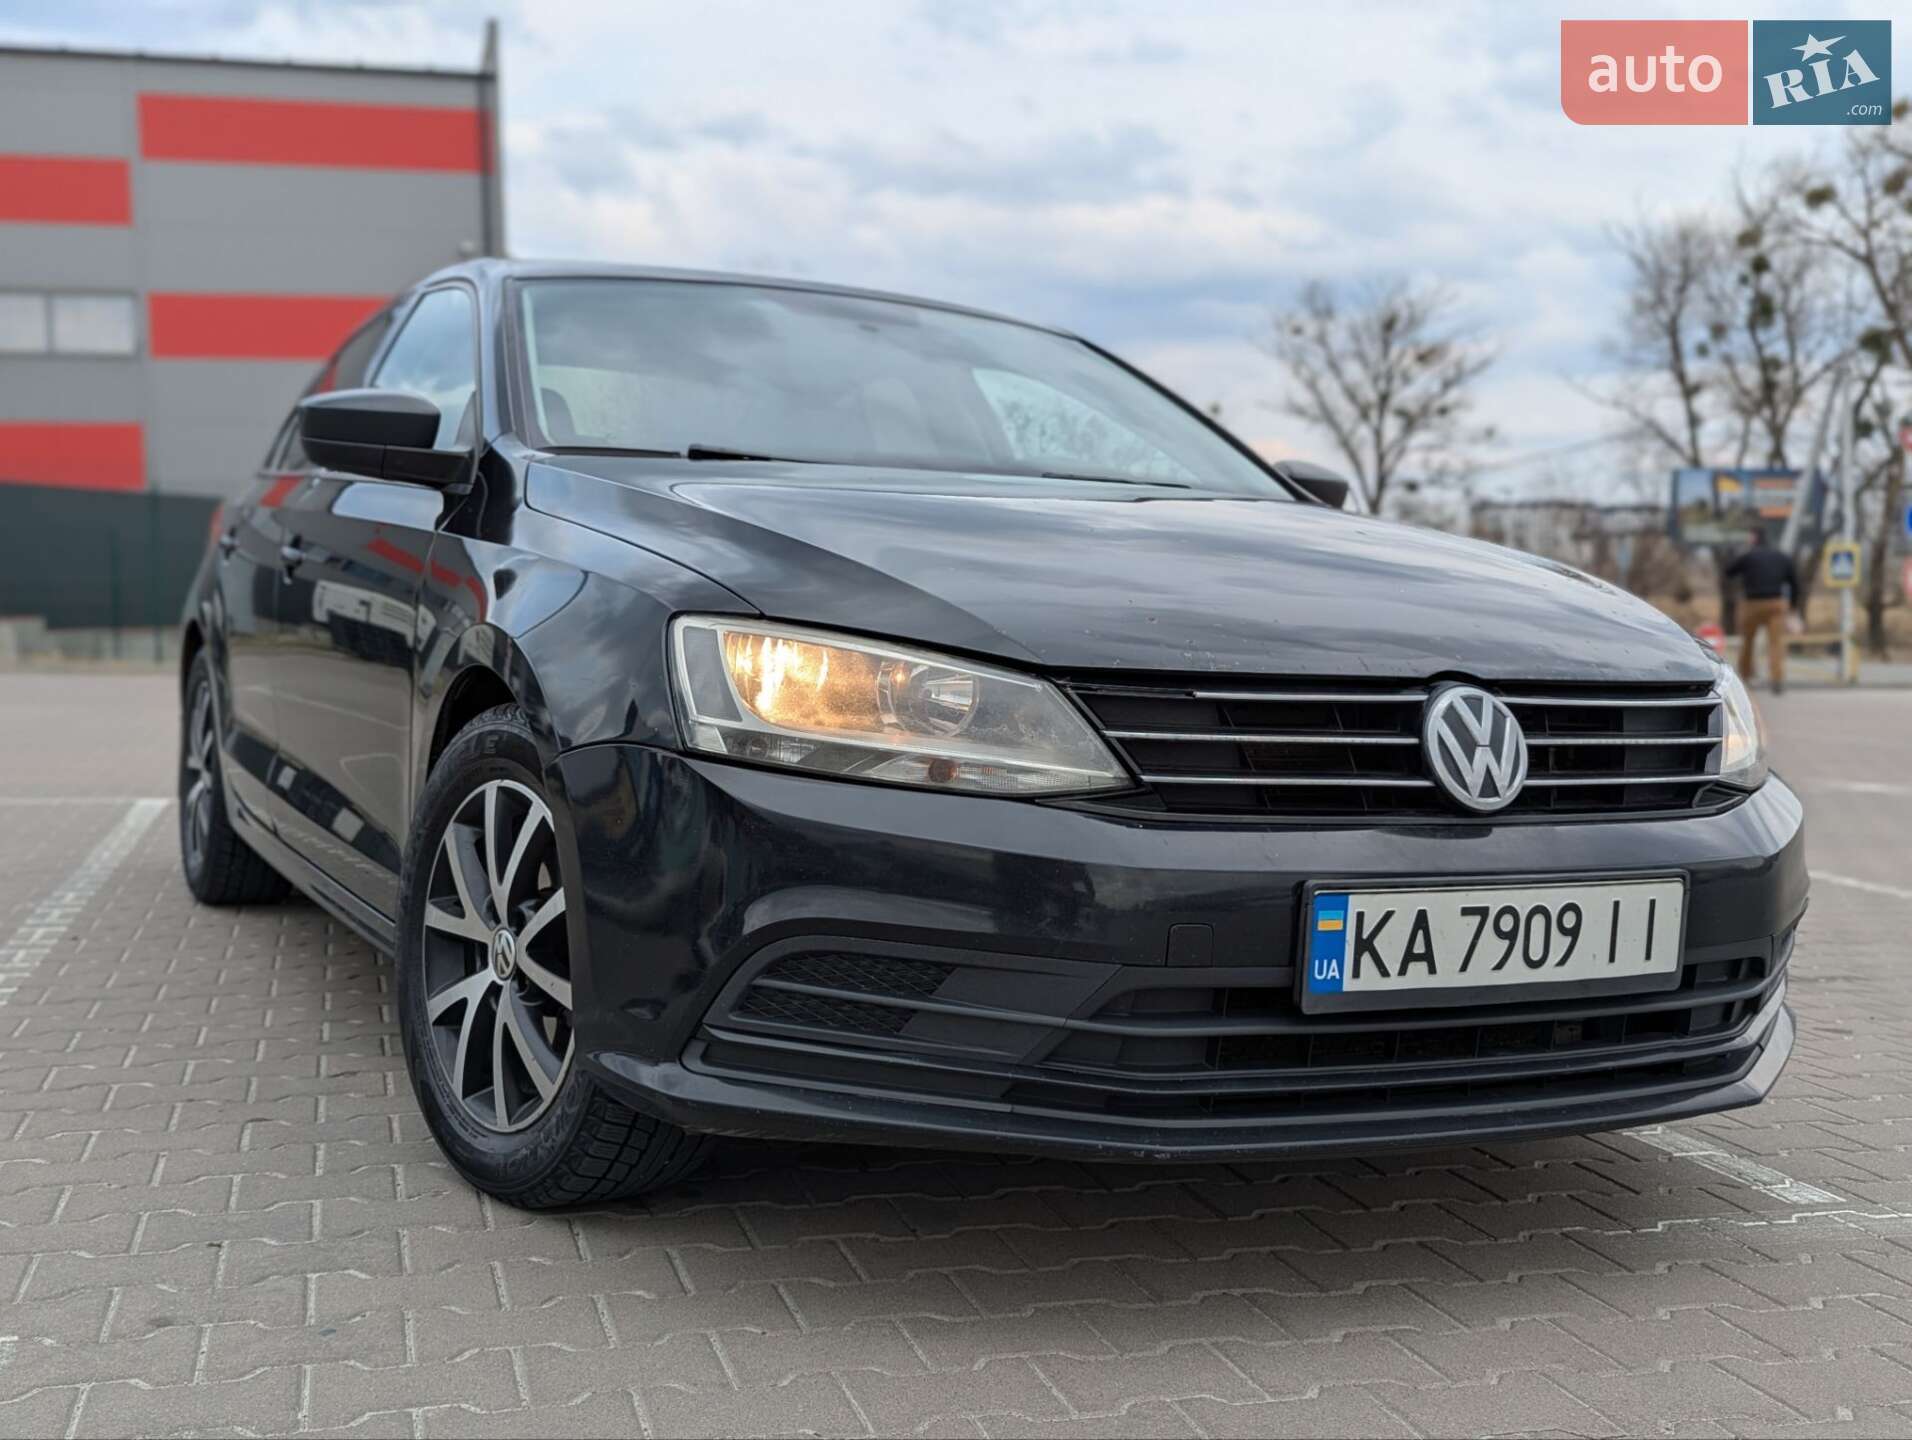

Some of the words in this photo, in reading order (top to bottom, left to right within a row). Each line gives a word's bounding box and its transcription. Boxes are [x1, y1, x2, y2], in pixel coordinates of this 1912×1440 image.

[1352, 908, 1438, 980] KA
[1458, 902, 1584, 974] 7909
[1313, 959, 1341, 981] UA
